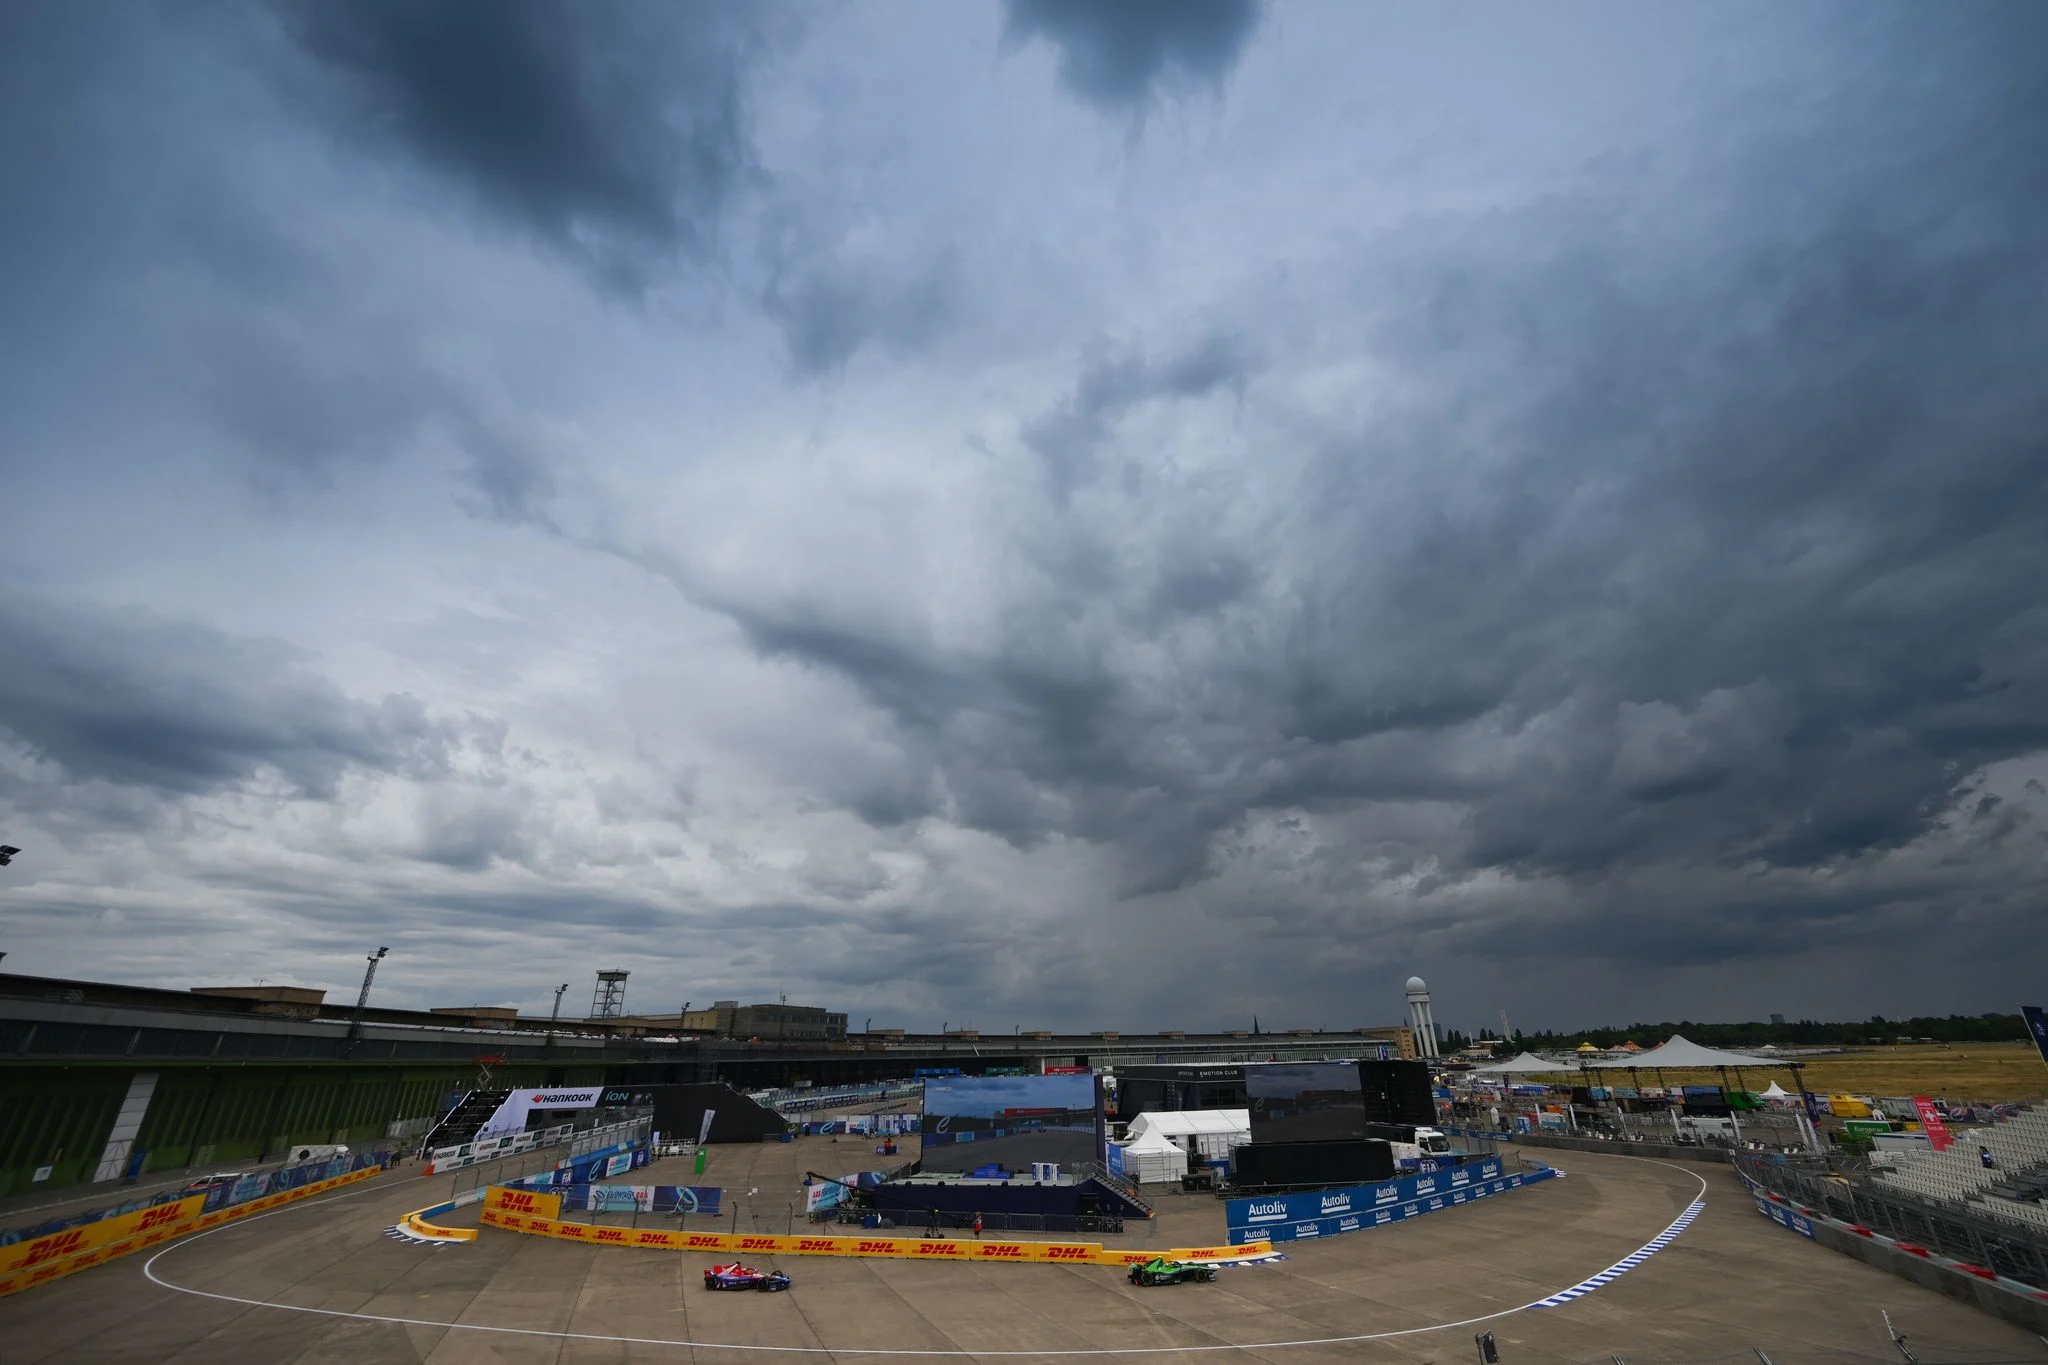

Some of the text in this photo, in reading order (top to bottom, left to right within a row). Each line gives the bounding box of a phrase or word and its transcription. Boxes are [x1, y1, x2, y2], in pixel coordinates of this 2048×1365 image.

[1483, 1163, 1497, 1174] Autoliv
[1452, 1169, 1469, 1181] Autoliv
[1417, 1177, 1435, 1189] Autoliv
[1376, 1185, 1397, 1198] Autoliv
[500, 1191, 535, 1213] DHL
[1321, 1193, 1350, 1207] Autoliv
[1248, 1201, 1287, 1215] Autoliv
[1405, 1203, 1417, 1213] Autoliv
[139, 1203, 182, 1231] DHL
[485, 1211, 497, 1222] DHL
[1376, 1210, 1390, 1220] Autoliv
[504, 1217, 520, 1227] DHL
[530, 1221, 549, 1232] DHL
[1340, 1216, 1359, 1226] Autoliv
[561, 1226, 582, 1236] DHL
[1296, 1223, 1318, 1233] Autoliv
[597, 1230, 622, 1241] DHL
[640, 1233, 669, 1244] DHL
[1244, 1229, 1270, 1239] Autoliv
[688, 1236, 720, 1247] DHL
[741, 1238, 776, 1249] DHL
[799, 1240, 835, 1250] DHL
[859, 1242, 896, 1252] DHL
[24, 1230, 83, 1267] DHL
[919, 1243, 957, 1254] DHL
[982, 1245, 1021, 1256] DHL
[1048, 1247, 1088, 1258] DHL
[1191, 1250, 1216, 1258] DHL
[1237, 1246, 1259, 1254] DHL
[1124, 1255, 1148, 1263] DHL
